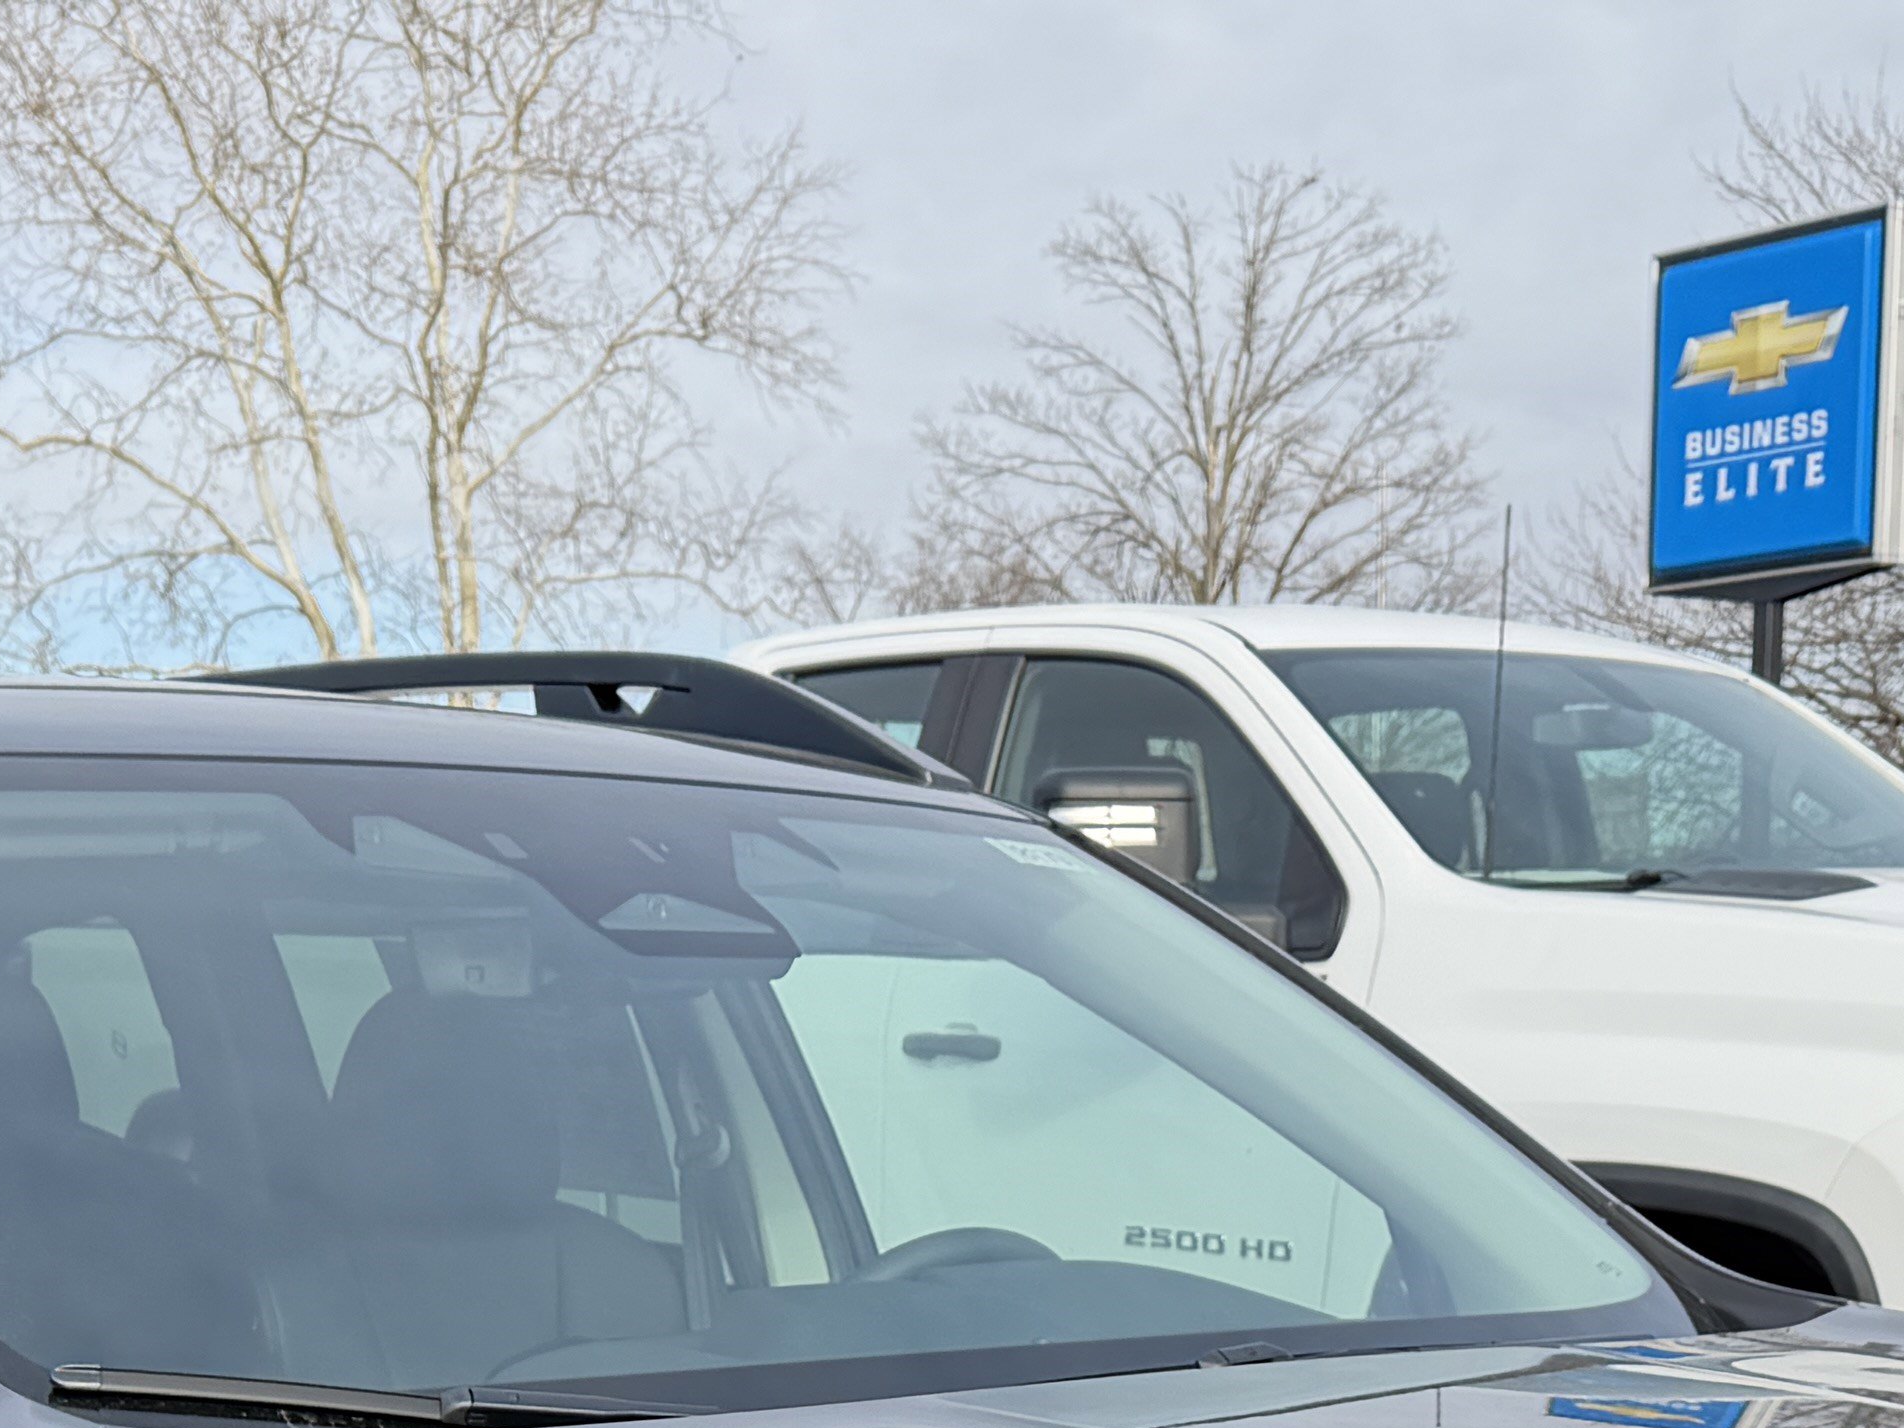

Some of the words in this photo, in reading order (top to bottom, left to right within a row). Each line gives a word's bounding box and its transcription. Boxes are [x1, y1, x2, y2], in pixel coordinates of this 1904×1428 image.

[1684, 408, 1829, 461] BUSINESS
[1683, 452, 1826, 507] ELITE
[1124, 1225, 1226, 1255] 2500
[1240, 1237, 1293, 1262] HD
